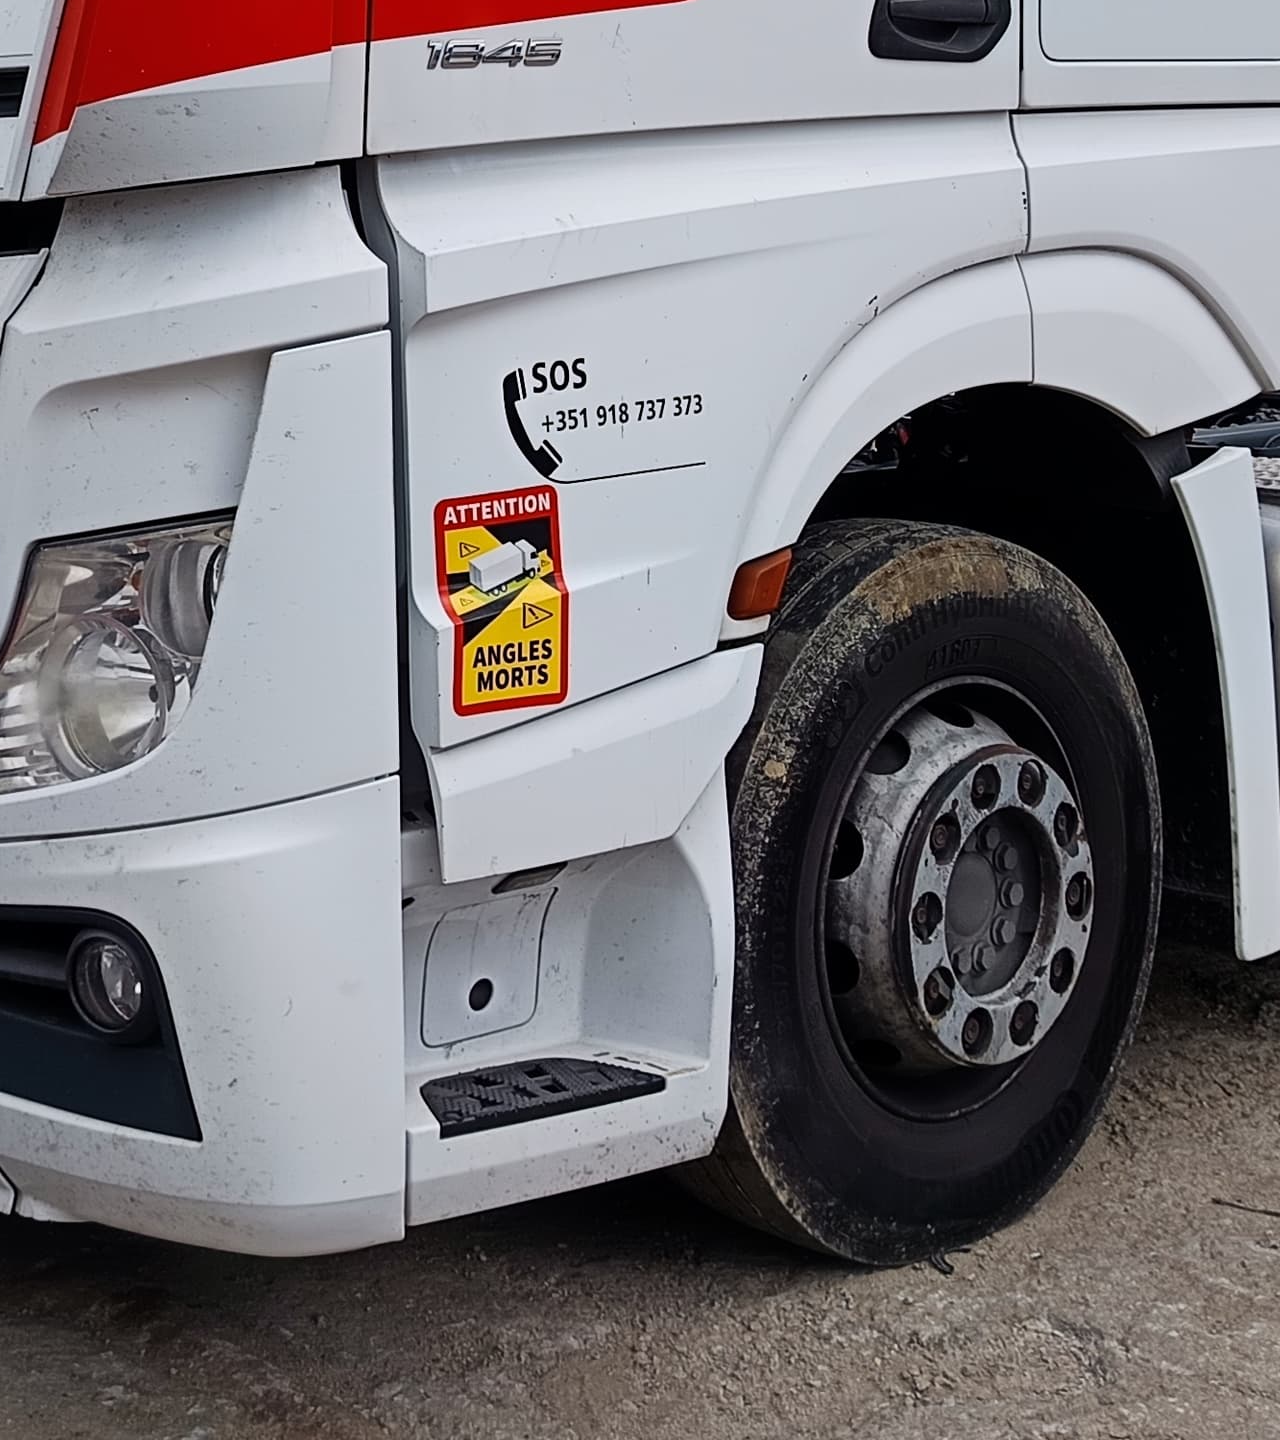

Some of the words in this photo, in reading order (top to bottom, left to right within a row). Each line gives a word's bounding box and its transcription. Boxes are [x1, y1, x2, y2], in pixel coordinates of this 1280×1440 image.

[426, 38, 564, 70] 1845
[531, 357, 588, 394] SOS
[541, 407, 588, 433] +351
[596, 402, 630, 427] 918
[634, 398, 666, 421] 737
[672, 394, 703, 417] 373
[443, 492, 551, 526] ATTENTION
[472, 638, 553, 668] ANGLES
[477, 663, 550, 692] MORTS
